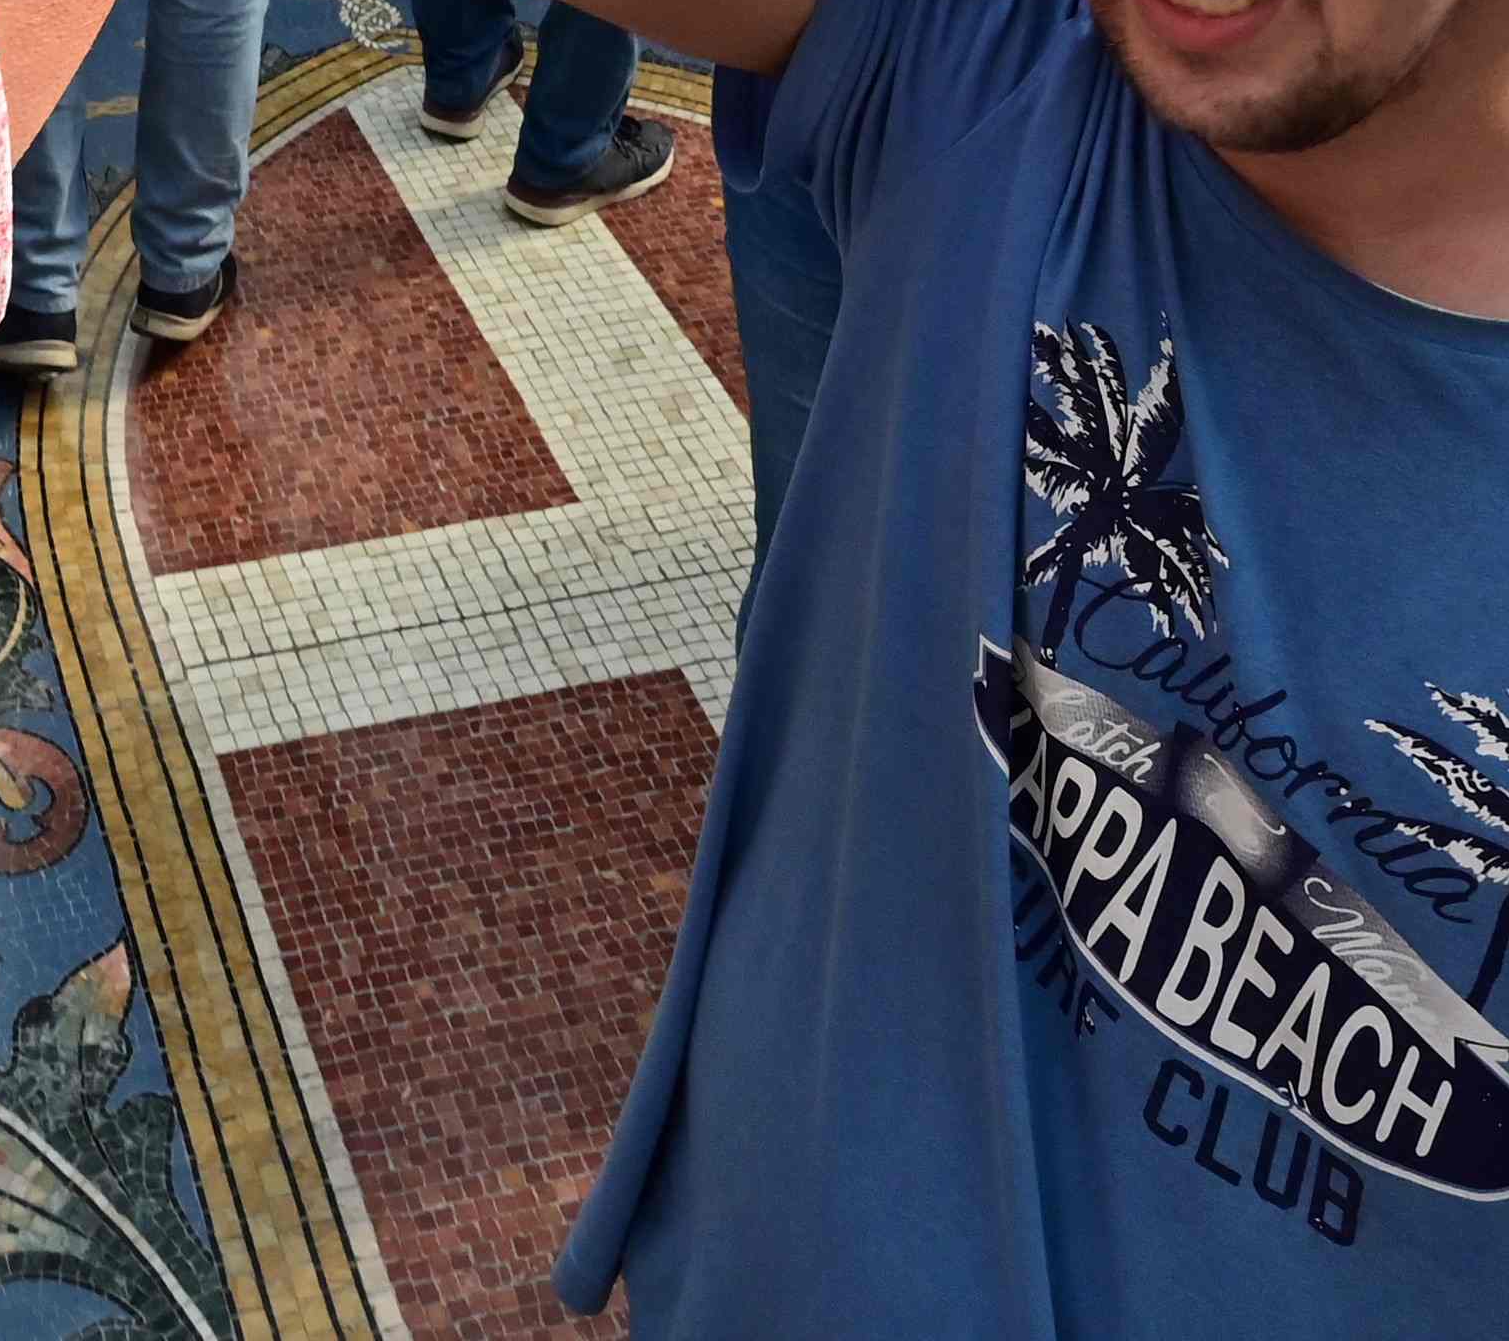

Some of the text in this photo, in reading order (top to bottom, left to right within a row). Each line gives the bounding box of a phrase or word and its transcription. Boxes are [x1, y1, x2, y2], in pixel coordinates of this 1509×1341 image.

[1074, 575, 1481, 925] California
[1008, 707, 1454, 1159] APPA BEACH
[1143, 1059, 1365, 1248] CLUB
